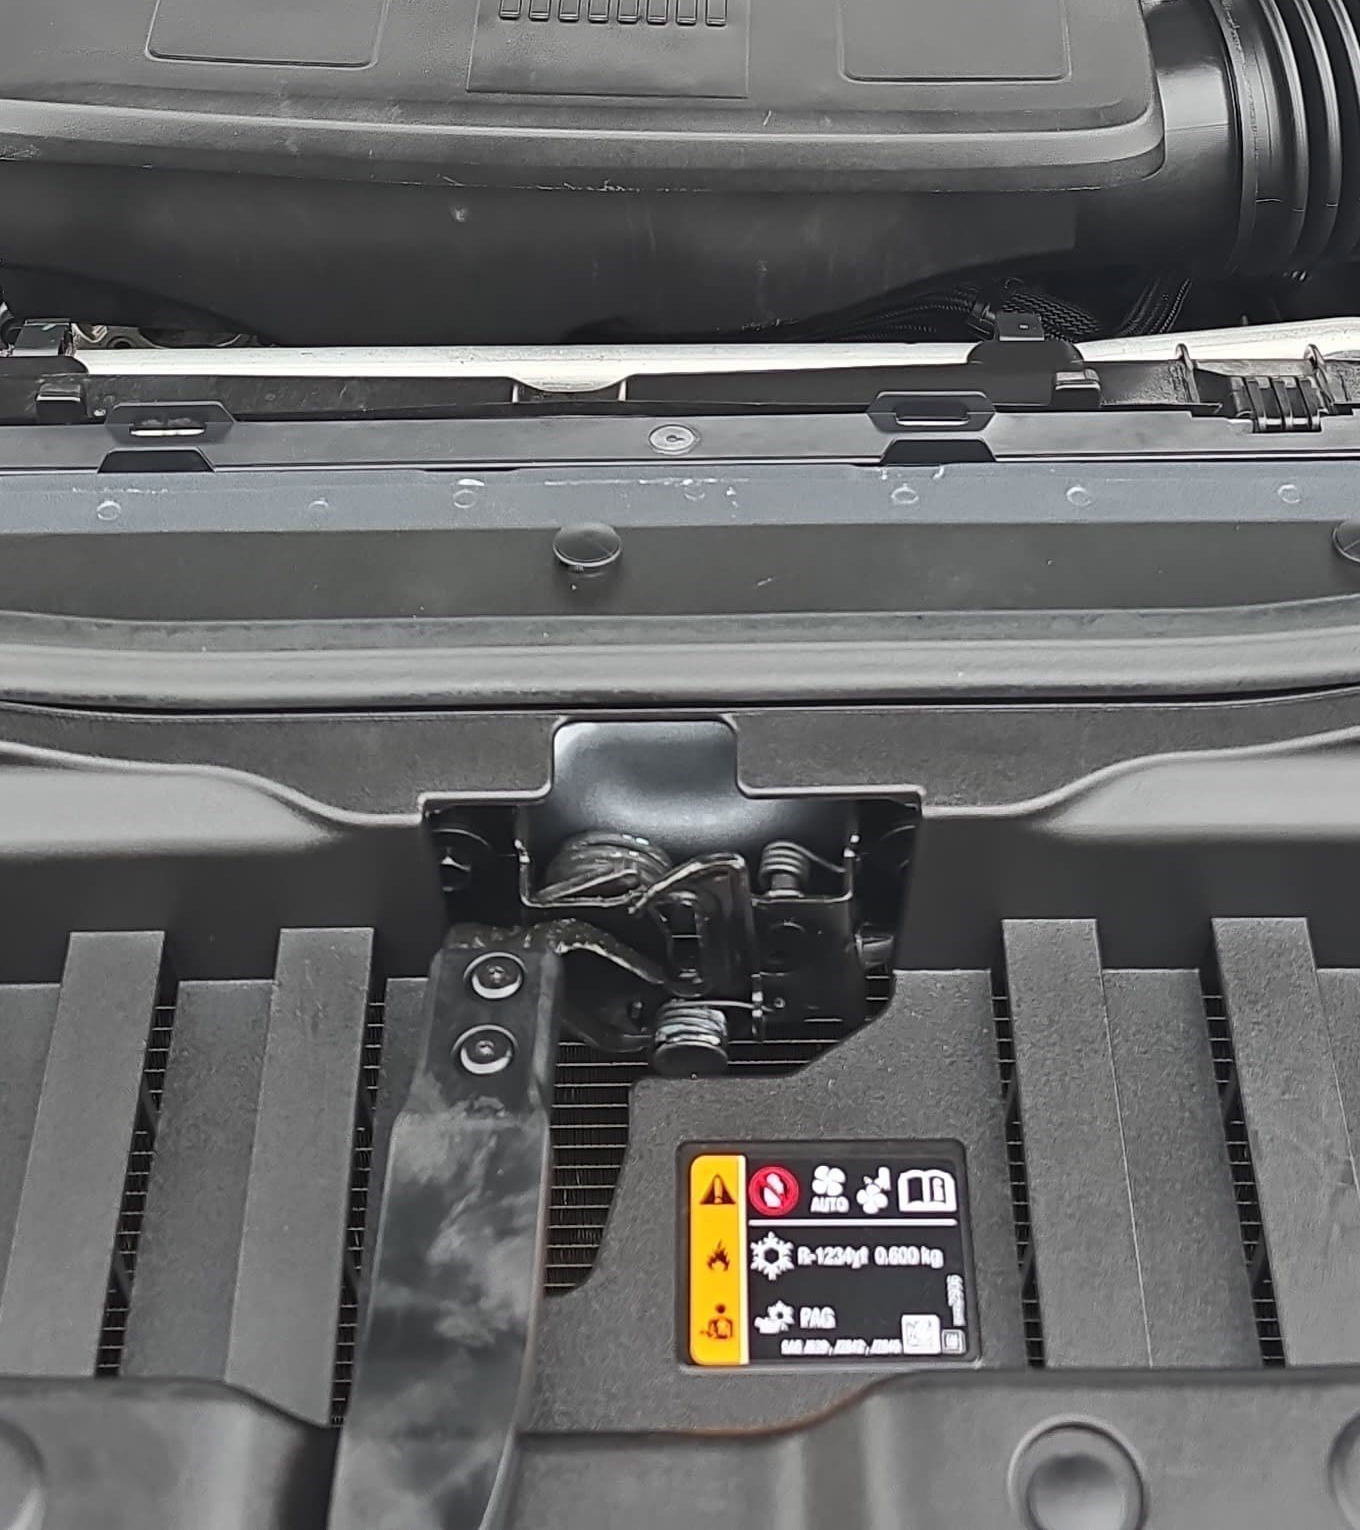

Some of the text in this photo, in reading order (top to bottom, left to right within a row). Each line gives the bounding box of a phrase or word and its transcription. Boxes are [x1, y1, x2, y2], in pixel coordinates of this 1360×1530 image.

[810, 1196, 850, 1213] AUTO
[875, 1246, 920, 1265] 0.600
[921, 1246, 944, 1268] kg
[800, 1306, 837, 1329] PAG
